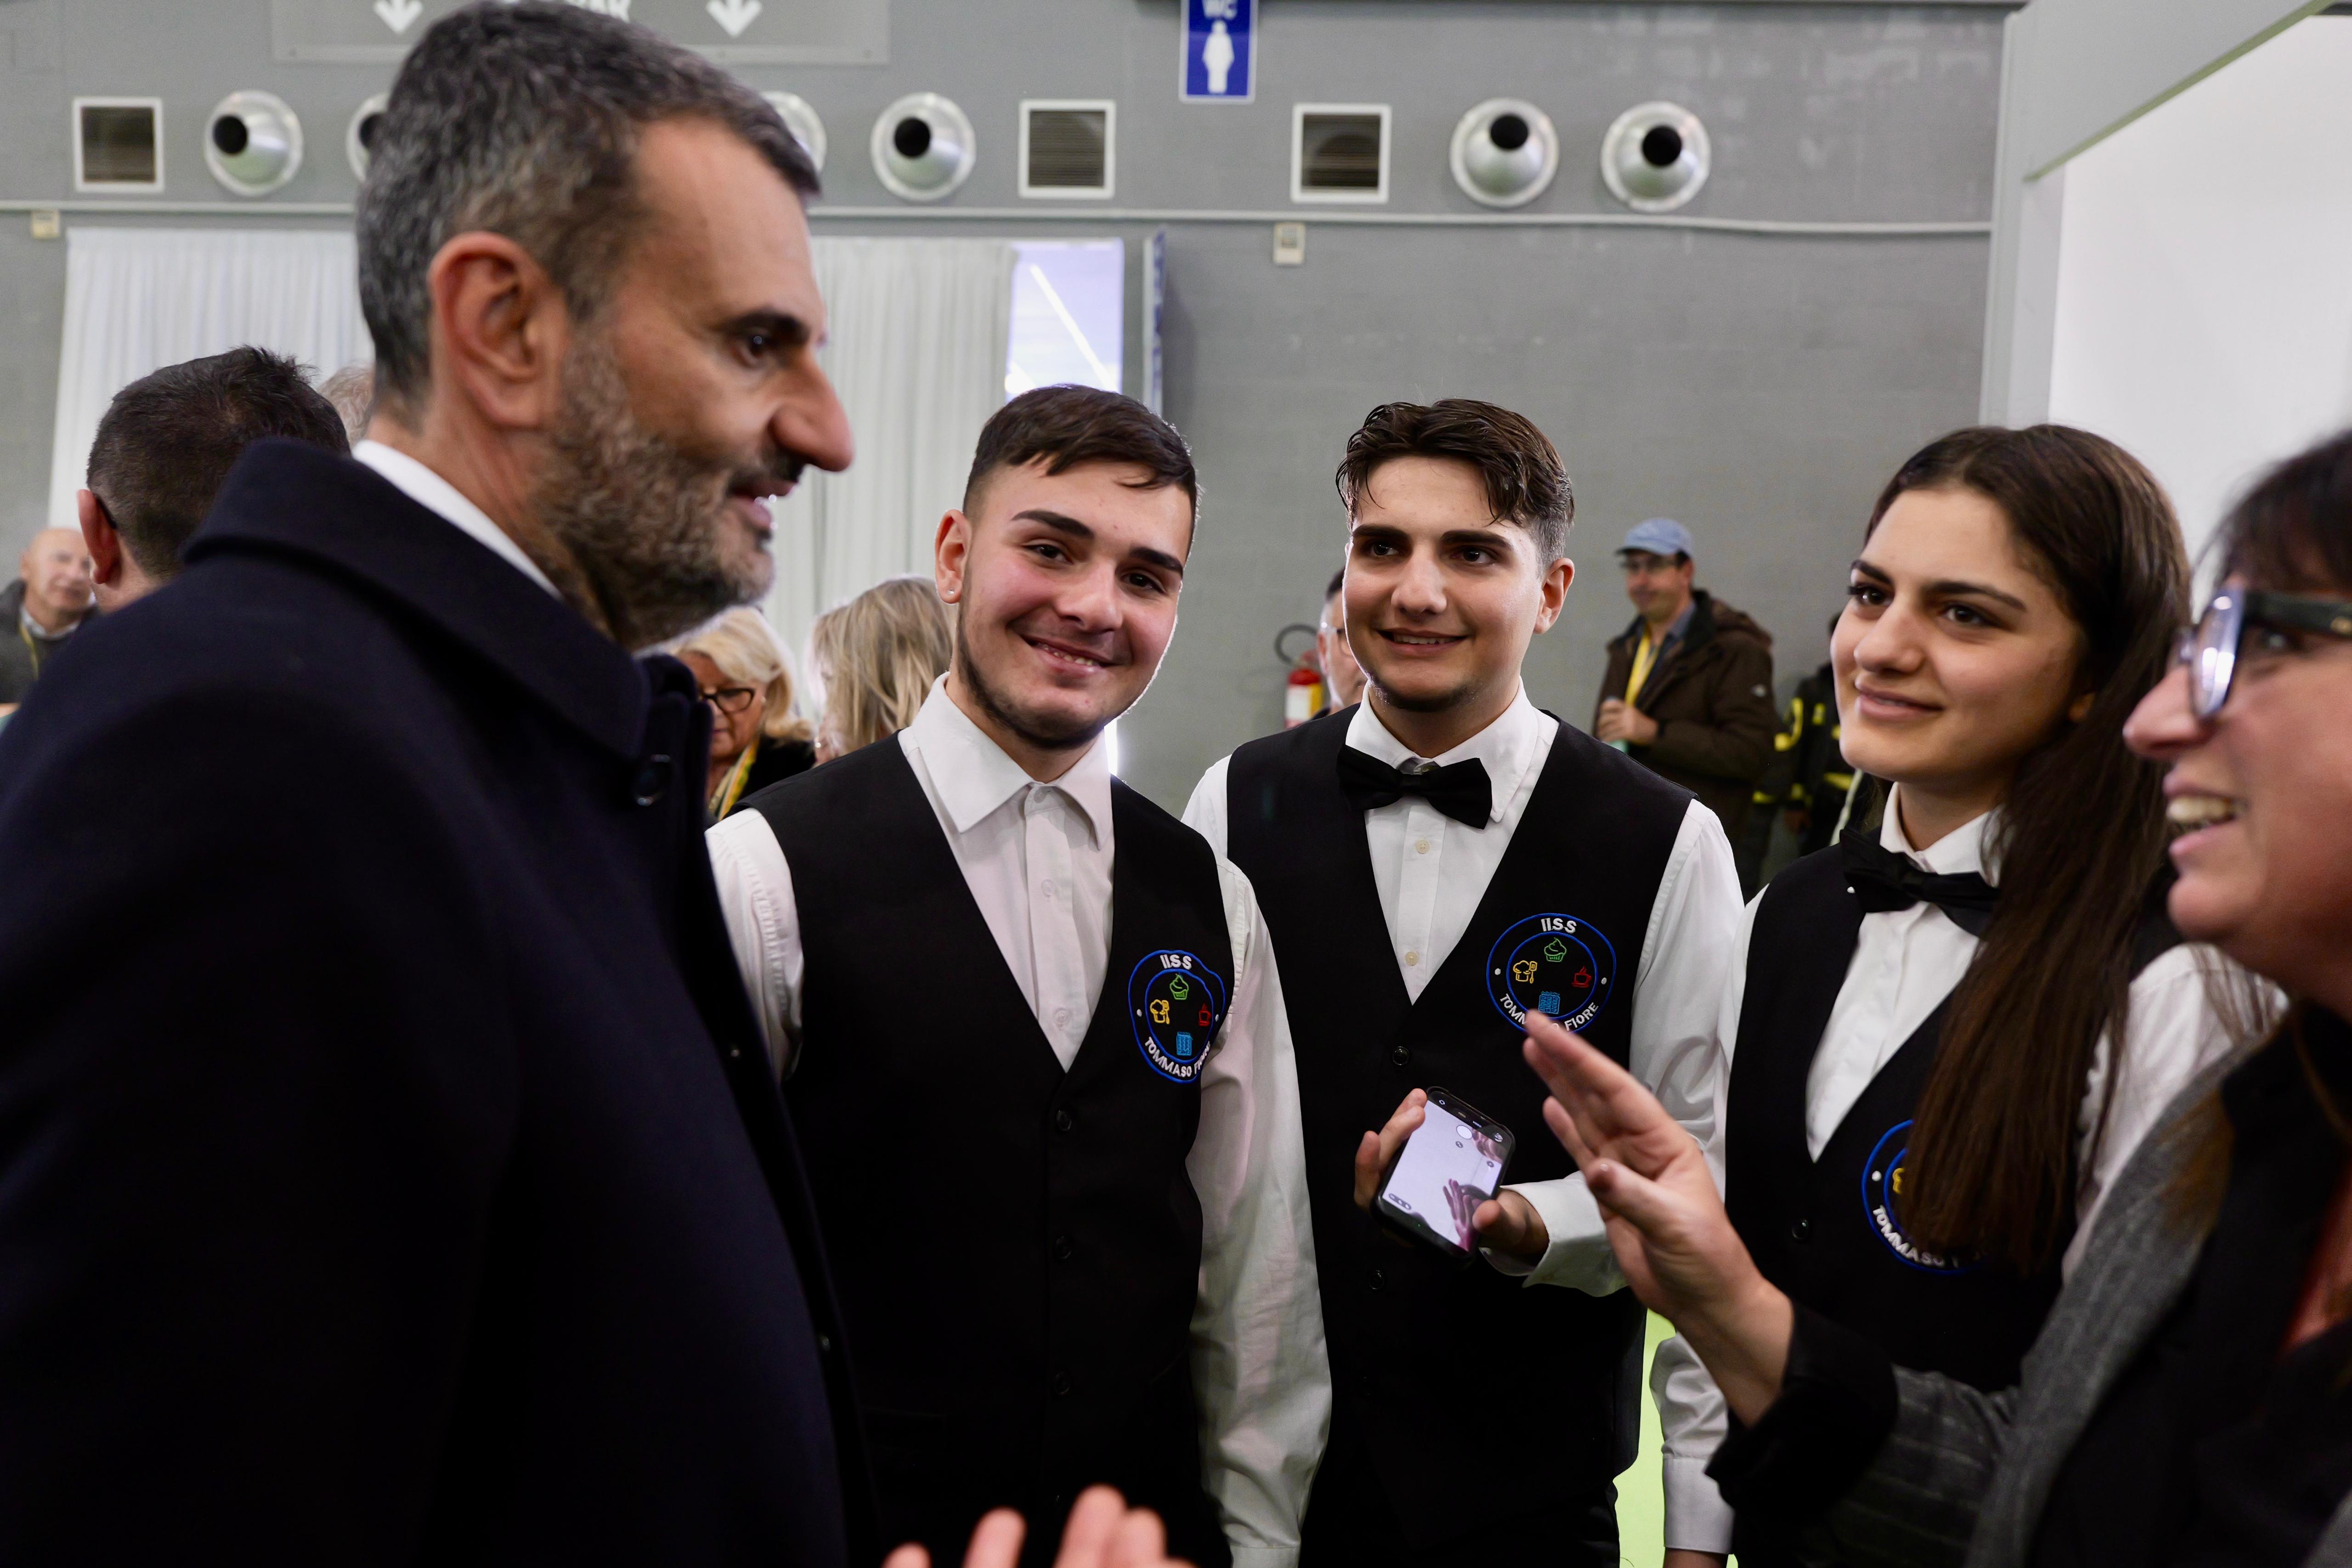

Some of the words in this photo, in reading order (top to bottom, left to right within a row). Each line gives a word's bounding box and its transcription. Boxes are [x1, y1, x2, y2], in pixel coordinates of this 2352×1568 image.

[1541, 918, 1577, 934] IISS
[1160, 954, 1192, 970] IISS
[1564, 1002, 1599, 1031] FIORE
[1144, 1036, 1192, 1077] TOMMASO
